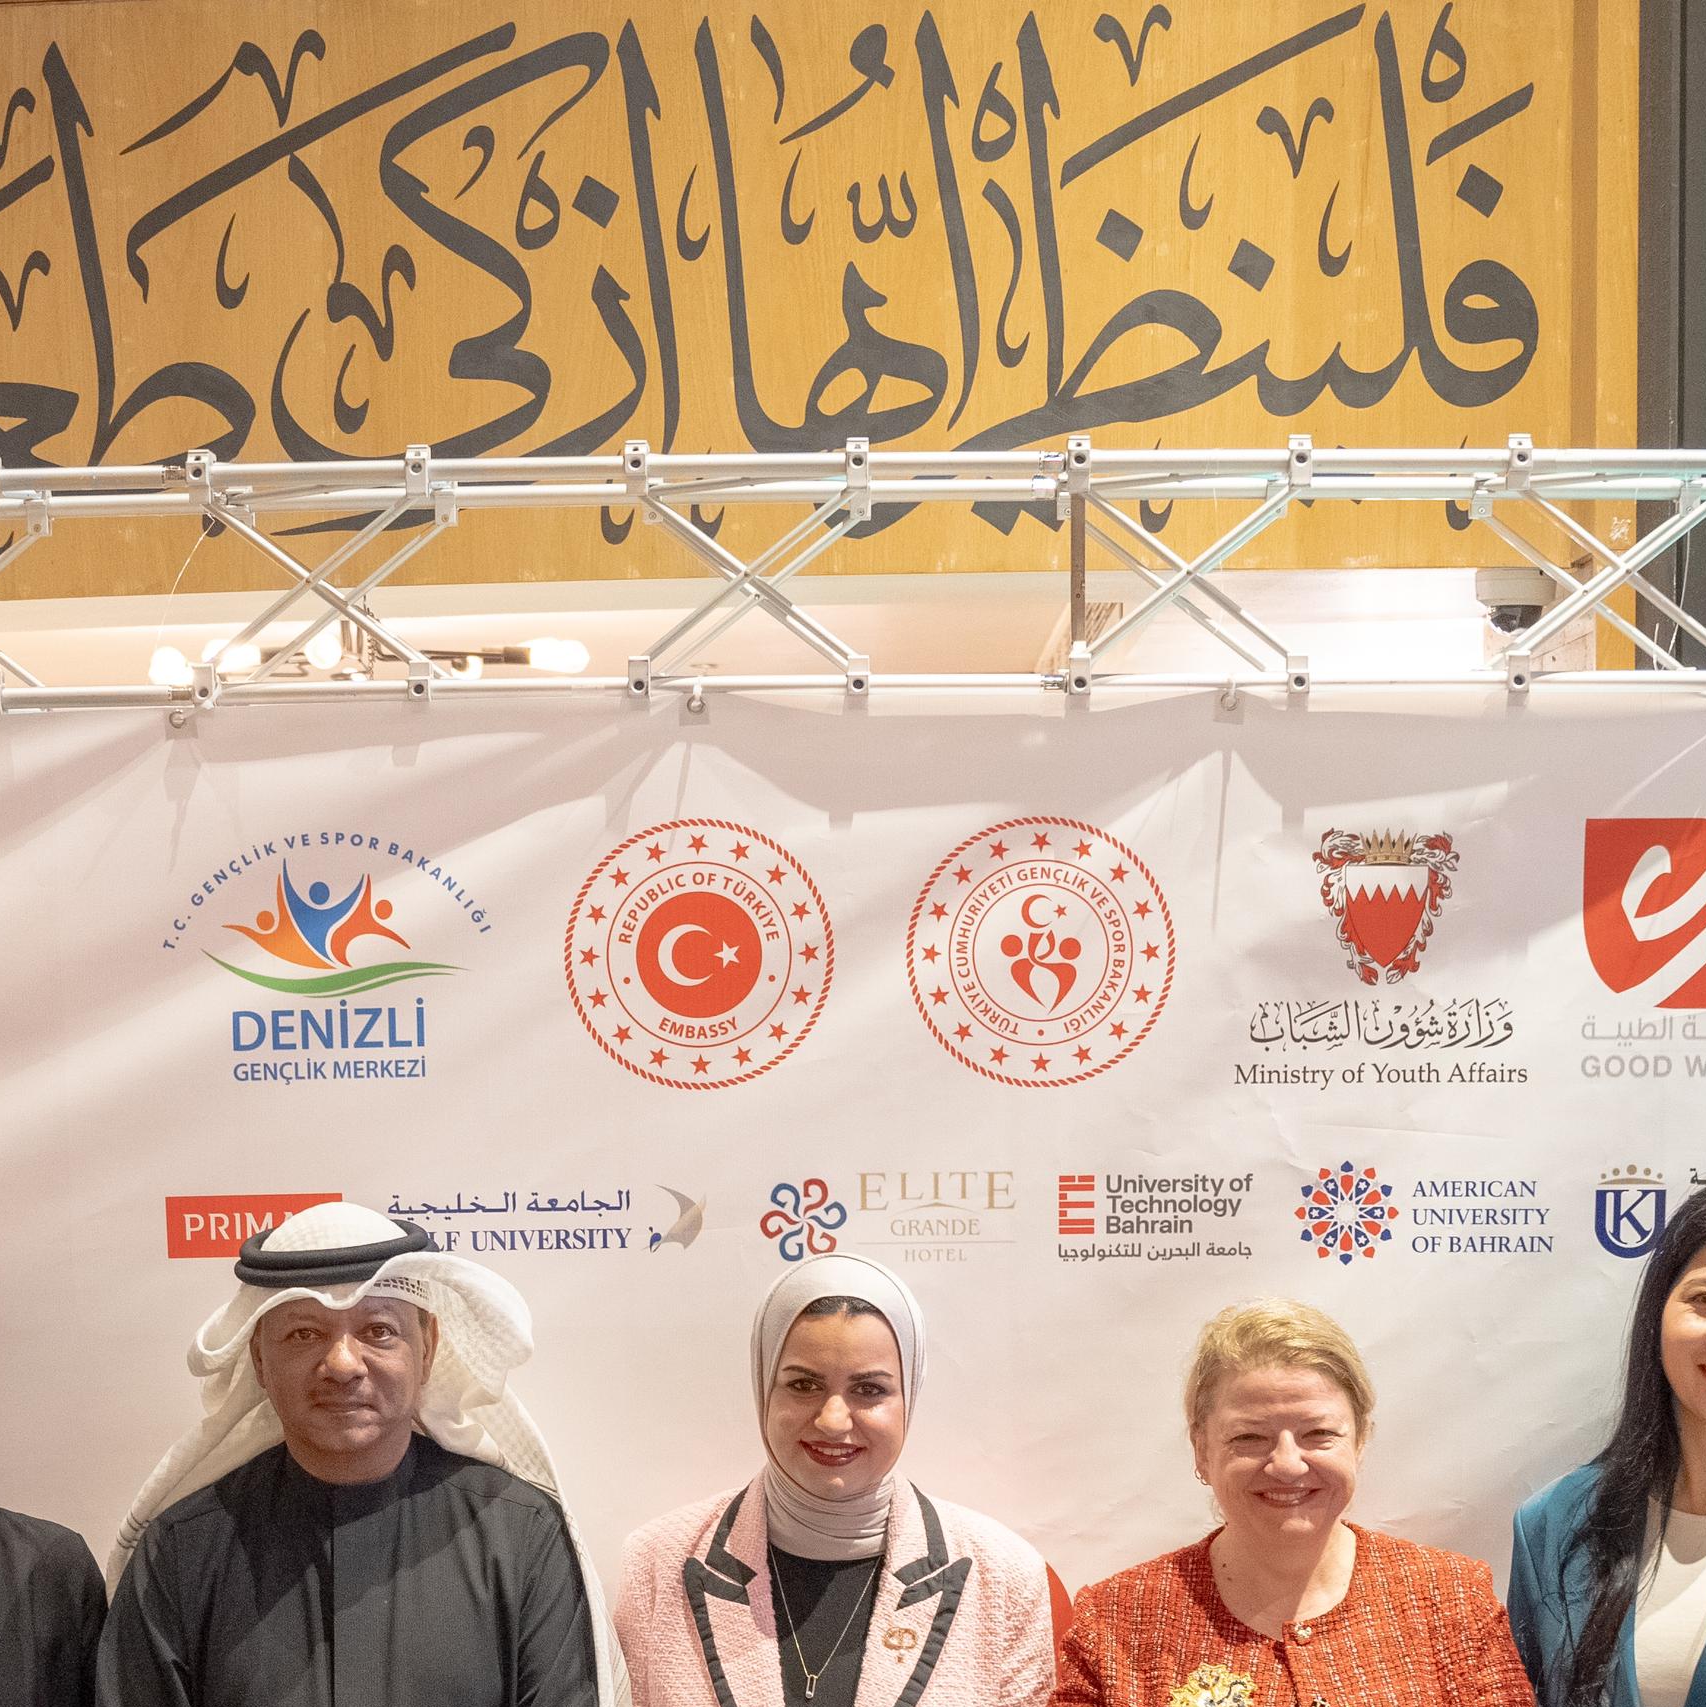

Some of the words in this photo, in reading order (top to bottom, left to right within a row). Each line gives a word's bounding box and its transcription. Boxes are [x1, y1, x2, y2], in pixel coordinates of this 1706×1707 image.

[190, 841, 277, 907] GENÇLİK
[284, 834, 311, 850] VE
[320, 831, 380, 851] SPOR
[387, 841, 493, 934] BAKANLIĞI
[1016, 866, 1089, 893] GENÇLİK
[618, 873, 687, 944] REPUBLIC
[692, 871, 717, 887] OF
[722, 876, 781, 942] TÜRKİYE
[1089, 886, 1110, 909] VE
[956, 871, 1014, 979] CUMHURİYETİ
[1103, 909, 1127, 955] SPOR
[962, 981, 1020, 1036] TÜRKİYE
[1063, 958, 1127, 1035] BAKANLIĞI
[231, 996, 426, 1052] DENİZLİ
[658, 1015, 739, 1040] EMBASSY
[233, 1058, 328, 1086] GENÇLİK
[332, 1055, 427, 1081] MERKEZİ
[1234, 1061, 1335, 1087] Ministry
[1340, 1062, 1367, 1084] of
[1370, 1063, 1441, 1084] Youth
[1447, 1062, 1529, 1084] Affairs
[1580, 1054, 1673, 1080] GOOD
[855, 1170, 1018, 1212] ELITE
[1105, 1174, 1227, 1197] University
[1231, 1172, 1254, 1193] of
[1411, 1179, 1539, 1199] AMERICAN
[1106, 1194, 1243, 1218] Technology
[1411, 1206, 1551, 1227] UNIVERSITY
[182, 1212, 293, 1242] PRIM
[890, 1218, 982, 1238] GRANDE
[1105, 1215, 1194, 1236] Bahrain
[471, 1227, 632, 1252] UNIVERSITY
[1411, 1235, 1444, 1254] OF
[1447, 1235, 1555, 1254] BAHRAIN
[903, 1247, 969, 1263] HOTEL
